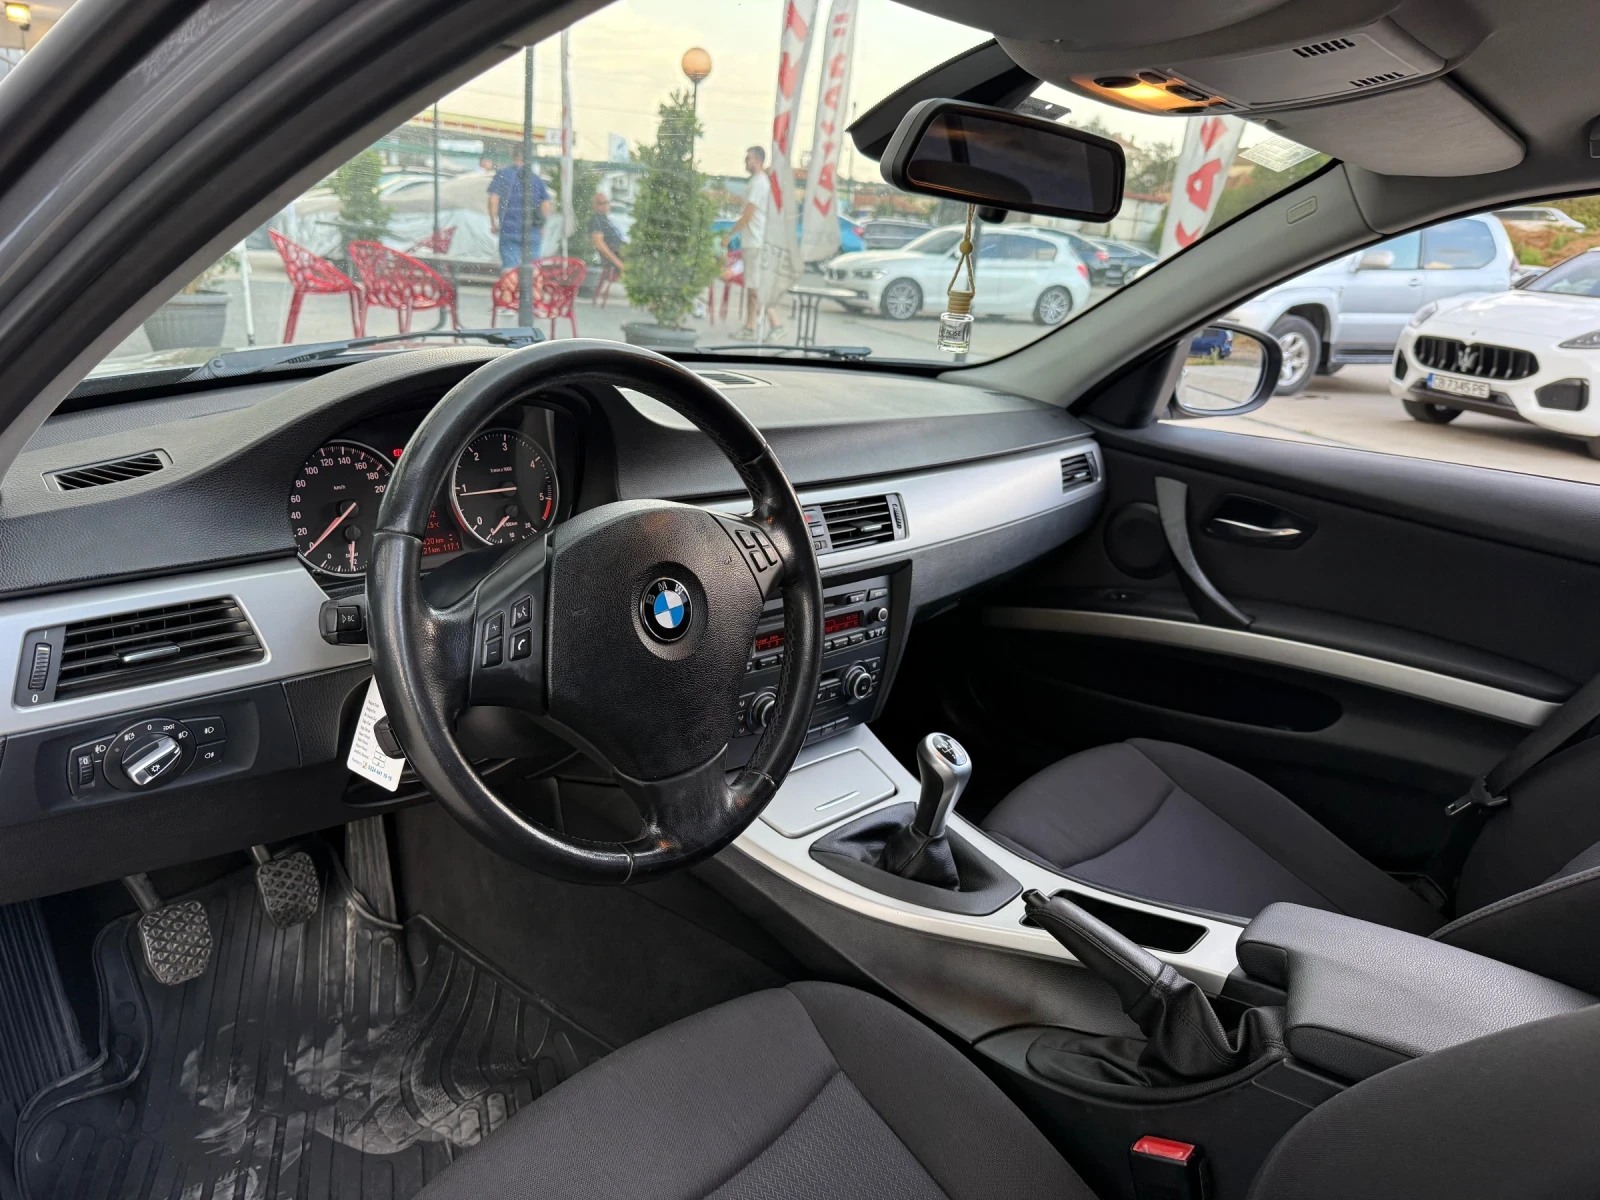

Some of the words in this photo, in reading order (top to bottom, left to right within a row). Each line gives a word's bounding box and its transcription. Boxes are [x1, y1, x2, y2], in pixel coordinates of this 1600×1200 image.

[502, 442, 508, 451] 3
[338, 456, 351, 465] 140
[473, 452, 480, 461] 2
[320, 458, 334, 467] 120
[354, 461, 368, 471] 160
[530, 460, 535, 469] 4
[304, 466, 319, 475] 100
[366, 471, 380, 481] 180
[295, 480, 306, 488] 80
[461, 483, 467, 493] 1
[290, 495, 301, 503] 60
[539, 492, 545, 501] 5
[291, 511, 301, 520] 40
[476, 516, 483, 525] 0
[297, 527, 307, 536] 20
[645, 581, 684, 606] BMW
[31, 693, 39, 704] 0
[147, 723, 153, 731] 0
[82, 757, 89, 765] 0
